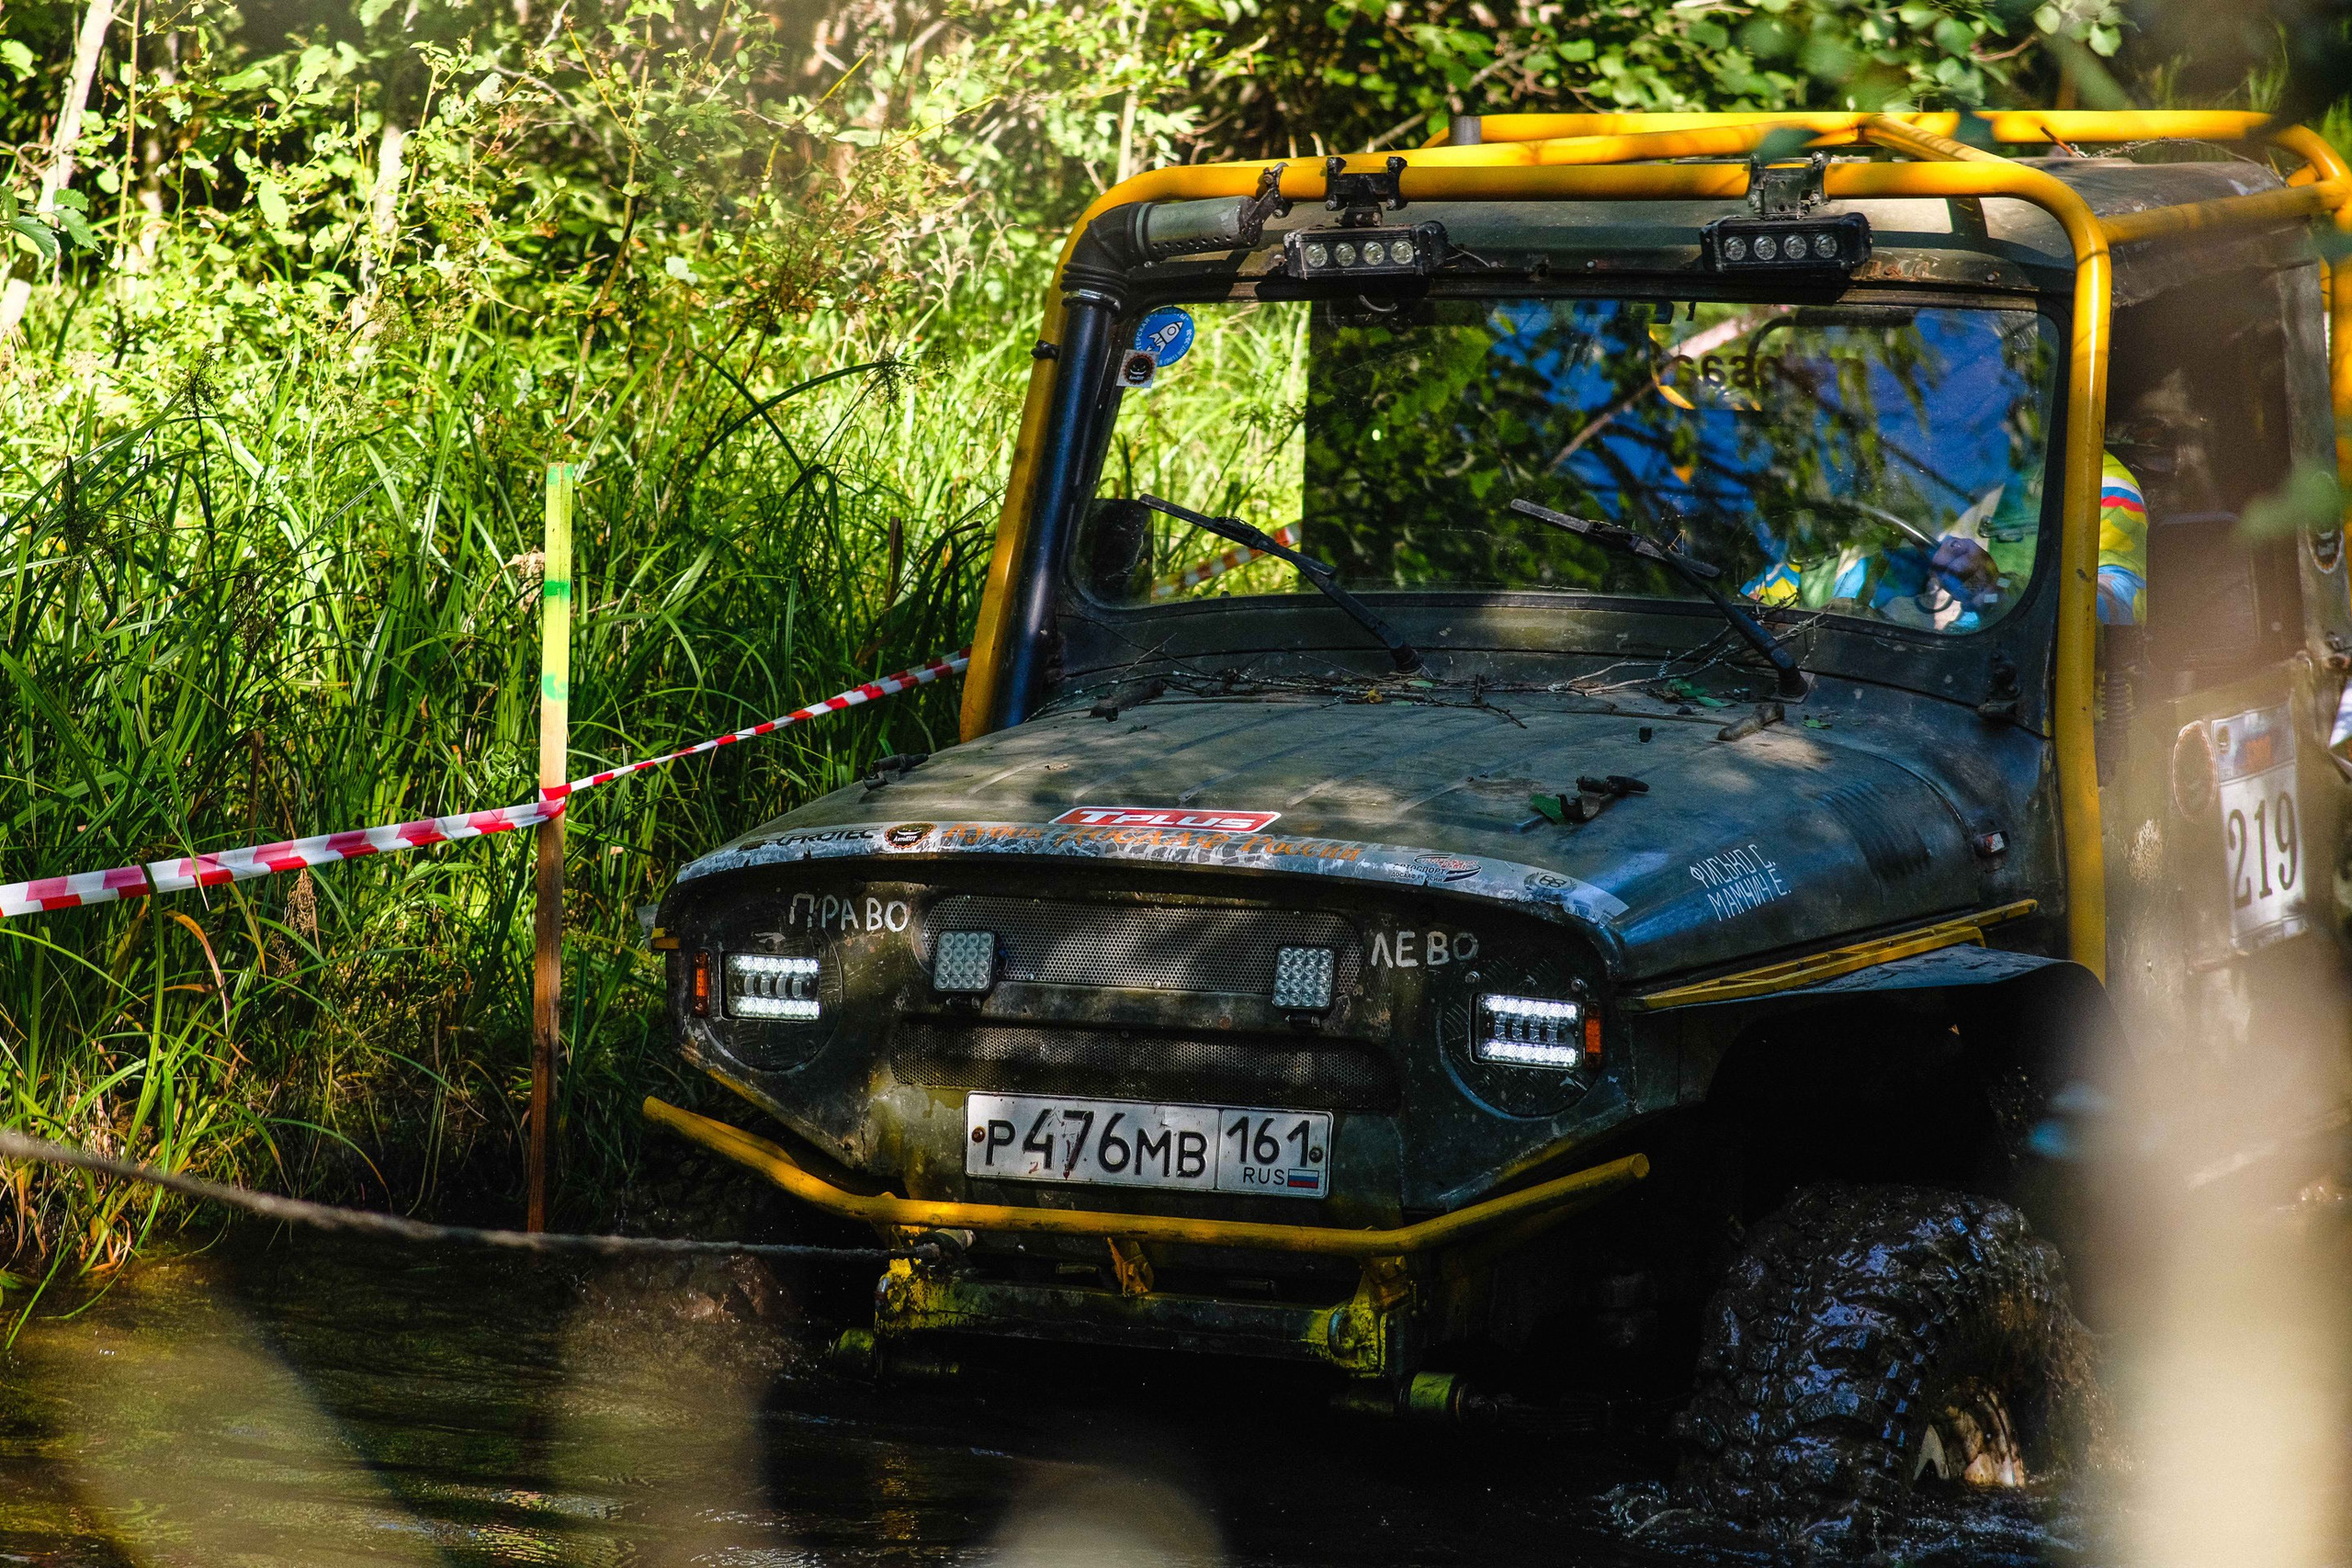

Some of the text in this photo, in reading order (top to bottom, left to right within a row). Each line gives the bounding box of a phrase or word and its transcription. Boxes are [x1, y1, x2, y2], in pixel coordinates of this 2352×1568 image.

[1080, 810, 1256, 829] TPLUS
[1054, 826, 1230, 849] ДОСААФ
[1240, 835, 1362, 862] России
[2228, 791, 2297, 909] 219
[1690, 849, 1757, 888] ФИСЬКО
[789, 893, 908, 932] ПРАВО
[1707, 873, 1774, 921] МАМЧИЧ
[1371, 931, 1479, 968] ЛЕВО
[1227, 1116, 1311, 1168] 161
[1243, 1167, 1285, 1186] RUS
